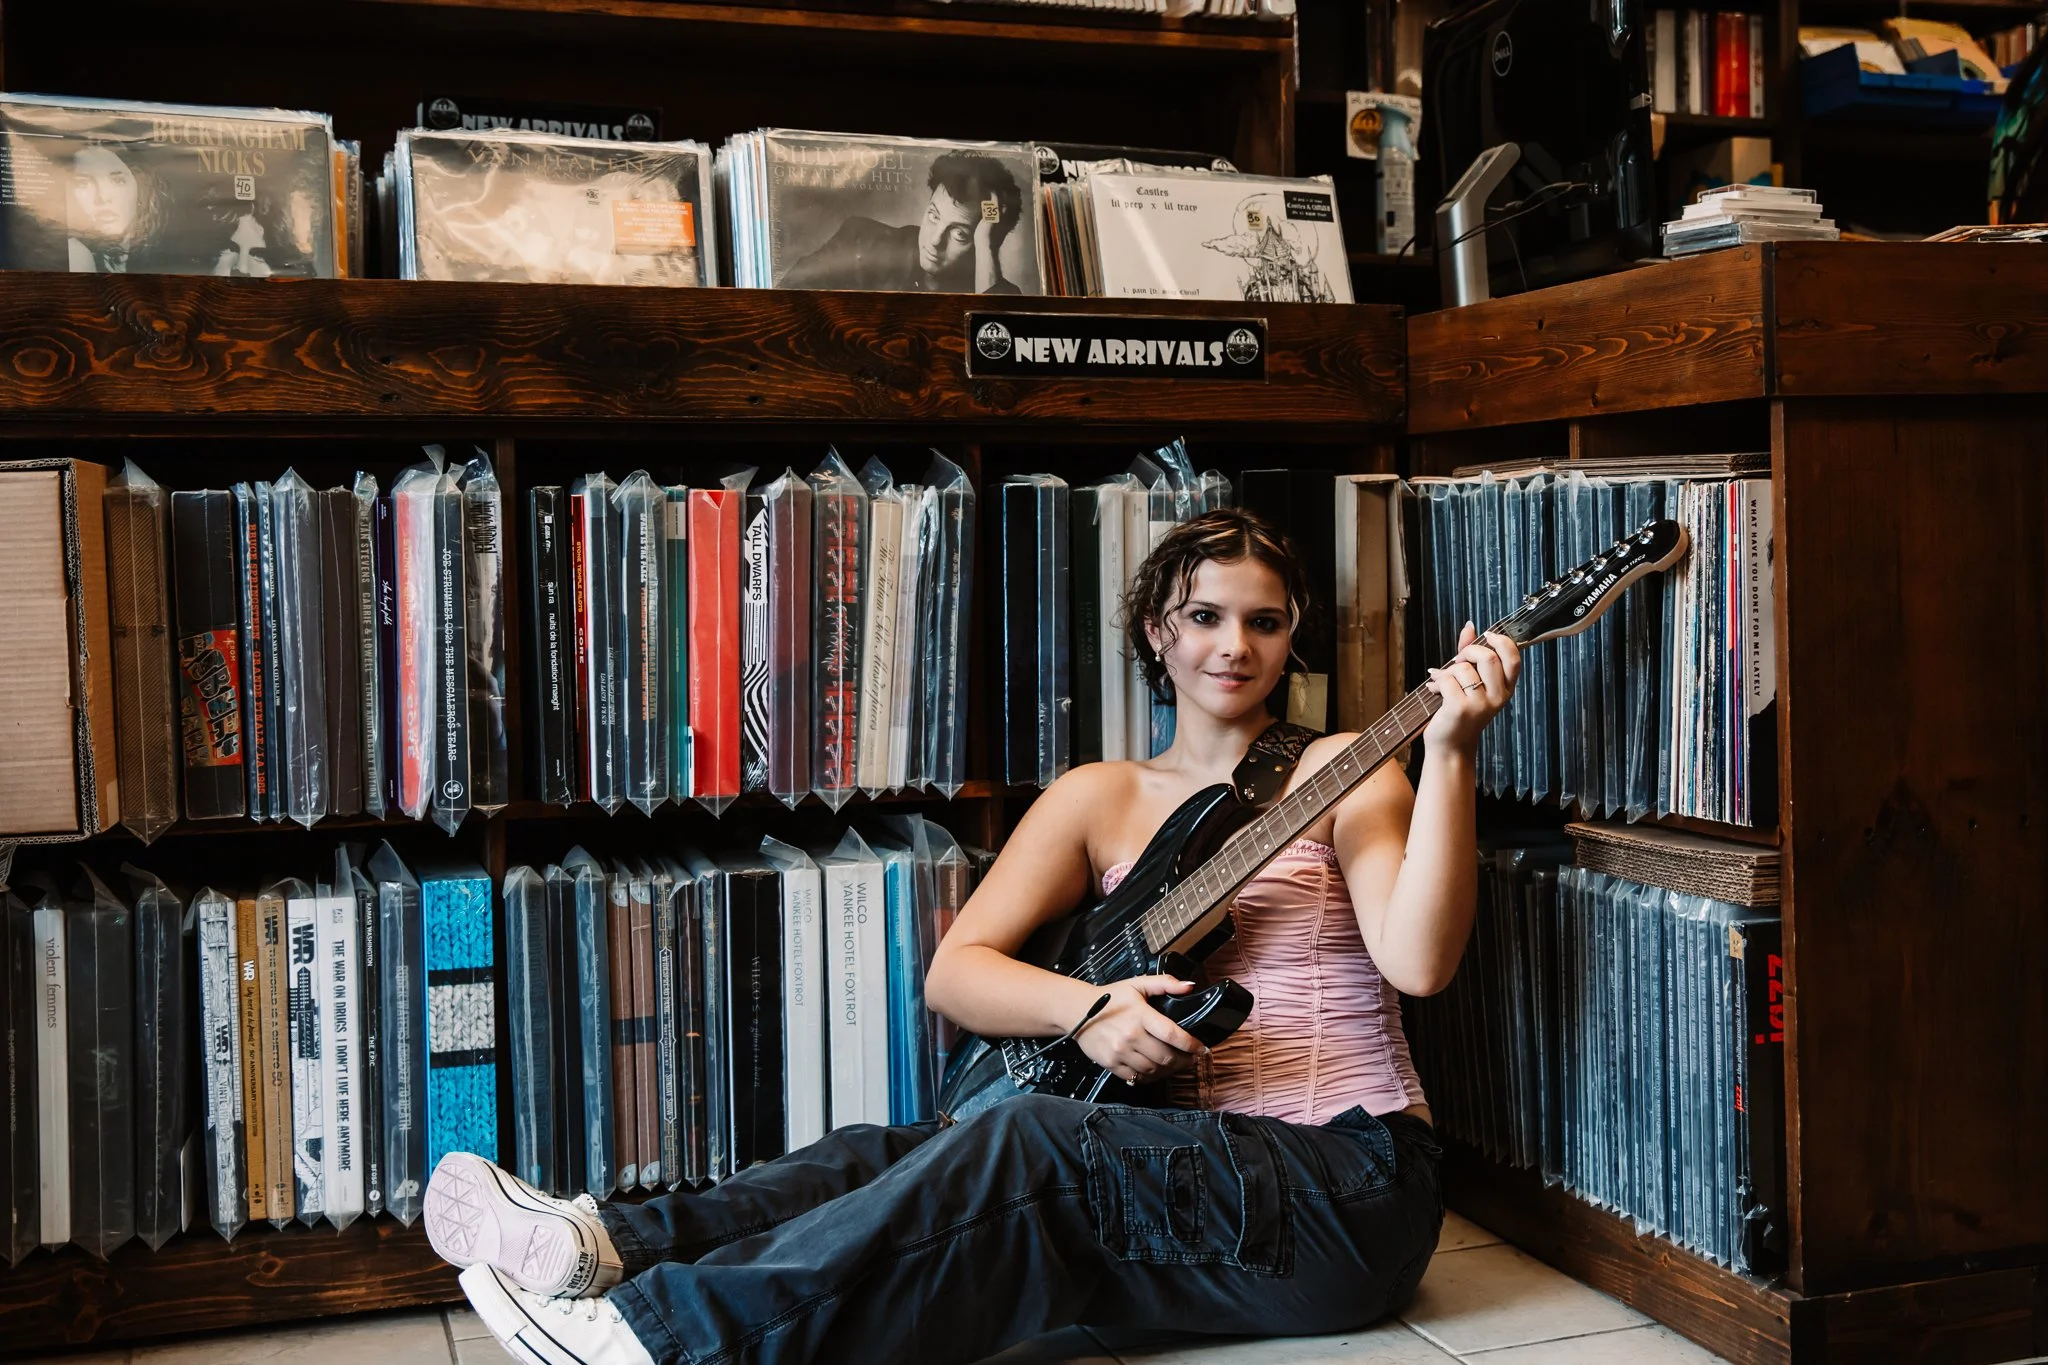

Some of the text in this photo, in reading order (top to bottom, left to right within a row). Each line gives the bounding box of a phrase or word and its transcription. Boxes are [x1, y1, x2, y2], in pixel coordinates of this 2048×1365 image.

[152, 119, 306, 151] BUCKINGHAM
[462, 114, 624, 141] NEW ARRIVALS
[197, 148, 266, 177] NICKS
[468, 149, 644, 173] VAN HALEN
[774, 144, 912, 170] BILLY JOEL
[774, 166, 912, 184] GREATEST HITS
[1136, 186, 1169, 197] Castles
[1125, 202, 1143, 210] peep
[1177, 203, 1198, 211] tracy
[1014, 337, 1224, 366] NEW ARRIVALS
[640, 537, 648, 545] IS
[640, 546, 648, 560] THE
[361, 543, 371, 583] STEVENS
[443, 548, 452, 567] JOE
[640, 561, 648, 583] PLACE
[752, 523, 762, 601] TALL DWARFS
[443, 569, 453, 620] STRUMMER
[547, 582, 555, 594] sun
[548, 596, 555, 604] ra
[1582, 573, 1618, 607] YAMAHA
[362, 593, 372, 624] CARRIE
[548, 613, 556, 630] nuits
[248, 523, 264, 767] BRUCE SPRINGSTEEN GRANDE FINALE/LA
[405, 628, 414, 666] PILOTS
[549, 631, 558, 640] de
[865, 539, 895, 731] The Tatum Solo Masterpieces
[363, 638, 374, 672] LOWELL
[445, 646, 454, 666] THE
[550, 649, 559, 682] fondation
[365, 682, 374, 707] TENTH
[445, 668, 456, 729] MESCALEROS
[550, 684, 560, 711] maeght
[366, 710, 376, 763] ANNIVERSARY
[406, 695, 416, 760] CORE
[446, 731, 457, 761] YEARS
[368, 767, 378, 797] EDITION
[802, 888, 812, 923] WILCO
[857, 882, 867, 924] WILCO
[264, 914, 278, 946] WAR
[293, 923, 315, 965] WAR
[269, 947, 277, 968] THE
[335, 939, 345, 957] THE
[792, 889, 804, 1007] YANKEE HOTEL FOXTROT
[843, 883, 857, 1027] YANKEE HOTEL FOXTROT
[45, 937, 62, 1029] violent femmes
[243, 960, 255, 981] WAR
[335, 959, 345, 982] WAR
[662, 955, 670, 996] WIDESPREAD
[269, 970, 277, 1006] WORLD
[335, 985, 346, 999] ON
[271, 1008, 278, 1020] IS
[336, 1001, 347, 1033] DRUGS
[750, 956, 763, 1087] WILCO ghost born
[216, 1024, 229, 1054] WAR
[272, 1030, 280, 1070] GHETTO
[337, 1045, 348, 1073] DON'T
[219, 1081, 229, 1105] VINYL
[272, 1071, 283, 1087] 50
[338, 1076, 349, 1096] LIVE
[665, 1073, 673, 1096] SUNDAY
[339, 1099, 350, 1122] HERE
[1734, 1085, 1745, 1113] jazz
[340, 1125, 351, 1171] ANYMORE
[566, 1251, 589, 1289] ALL STAR
[576, 1253, 595, 1290] CONVERSE
